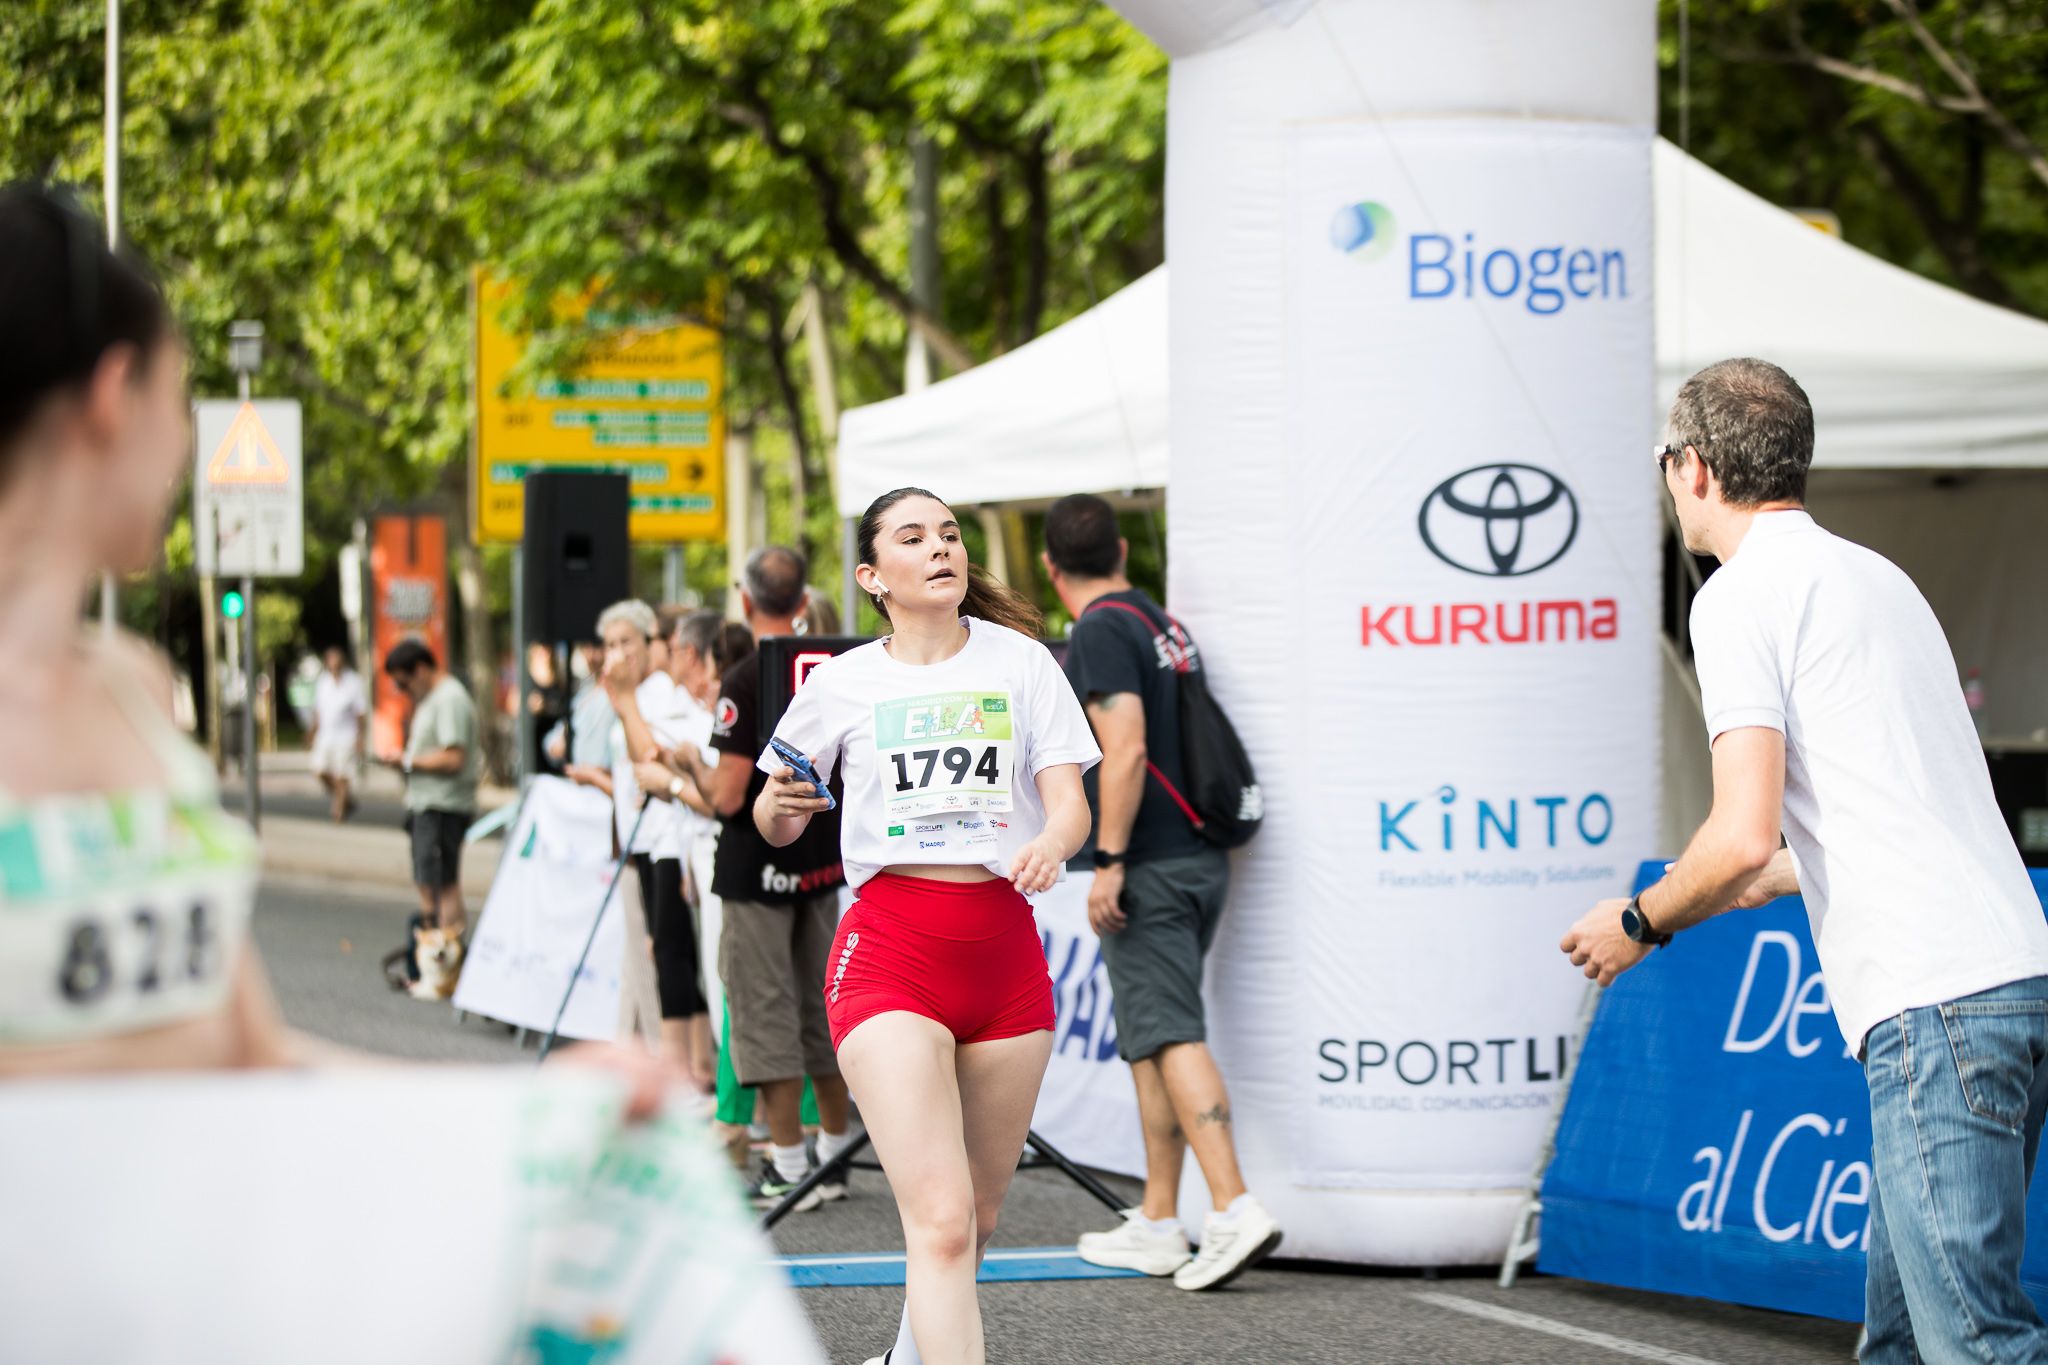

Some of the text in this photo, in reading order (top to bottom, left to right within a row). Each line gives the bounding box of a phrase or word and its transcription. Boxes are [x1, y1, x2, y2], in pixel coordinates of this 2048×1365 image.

[1409, 232, 1628, 316] Biogen
[903, 703, 984, 740] ELA
[891, 746, 1000, 792] 1794
[1723, 930, 1832, 1058] De
[1318, 1036, 1577, 1085] SPORTLI
[1677, 1109, 1871, 1252] al Cie
